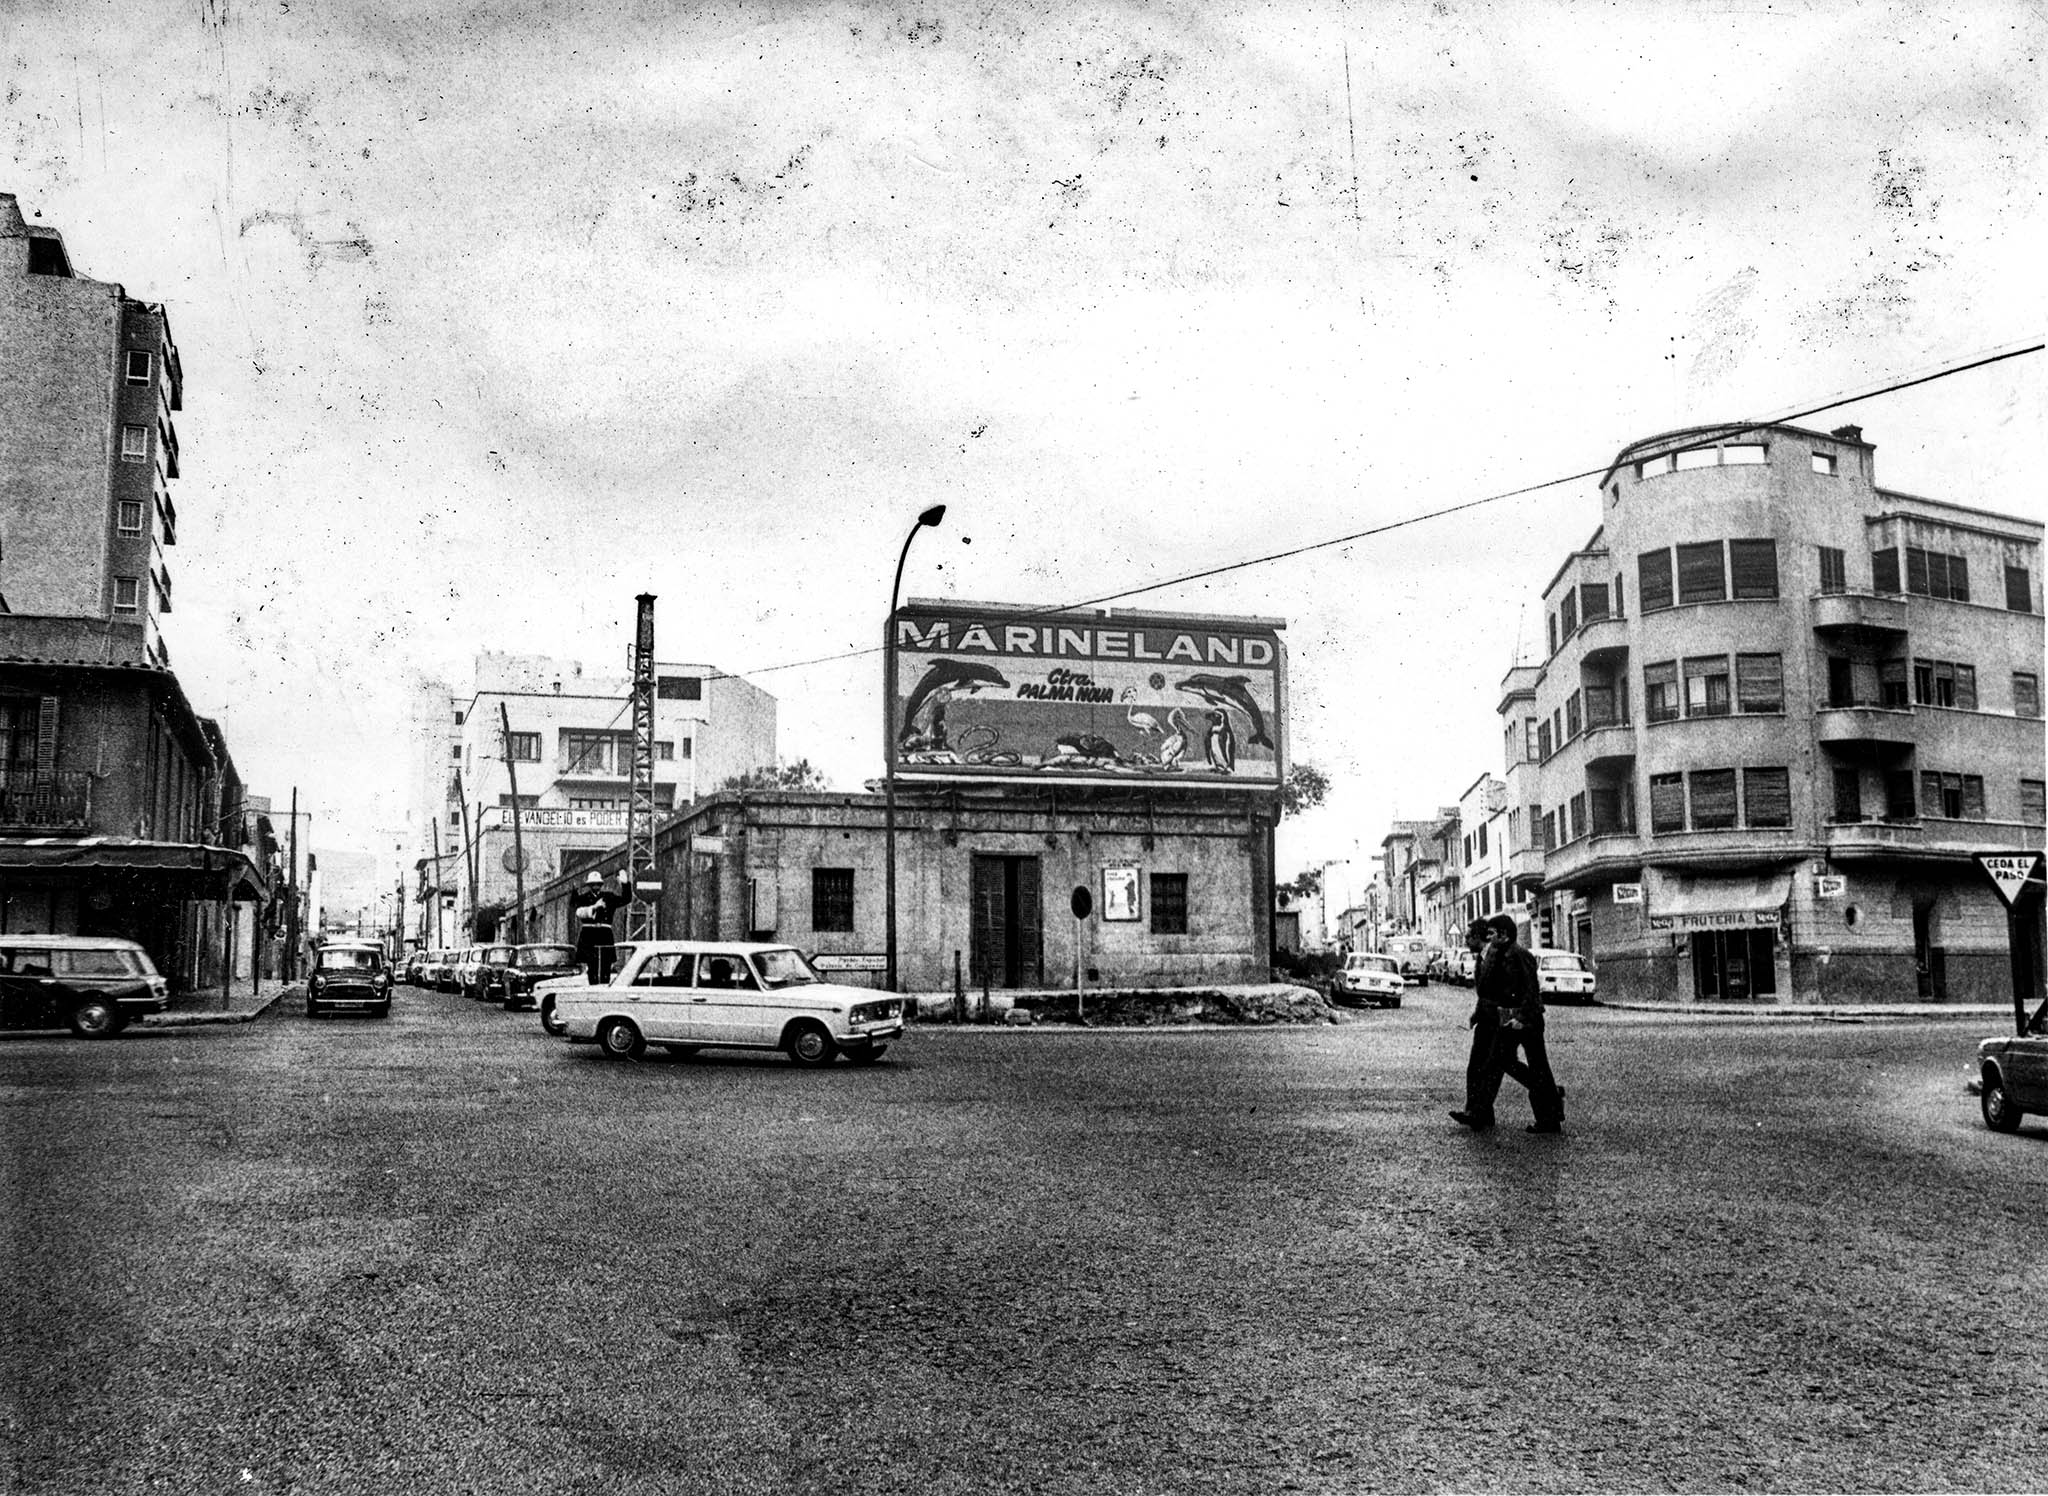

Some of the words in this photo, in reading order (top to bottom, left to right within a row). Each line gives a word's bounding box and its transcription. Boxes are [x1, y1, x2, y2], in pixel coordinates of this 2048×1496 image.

[898, 620, 1274, 666] MARINELAND
[1047, 667, 1095, 686] Ctra.
[1016, 683, 1075, 701] PALMA
[1075, 685, 1114, 703] NOVA
[502, 810, 513, 824] EL
[576, 816, 587, 826] es
[590, 811, 622, 826] PODER
[1987, 859, 2014, 869] CEDA
[2018, 859, 2029, 869] EL
[1995, 870, 2024, 880] PASO
[1682, 913, 1746, 927] FRUTERIA
